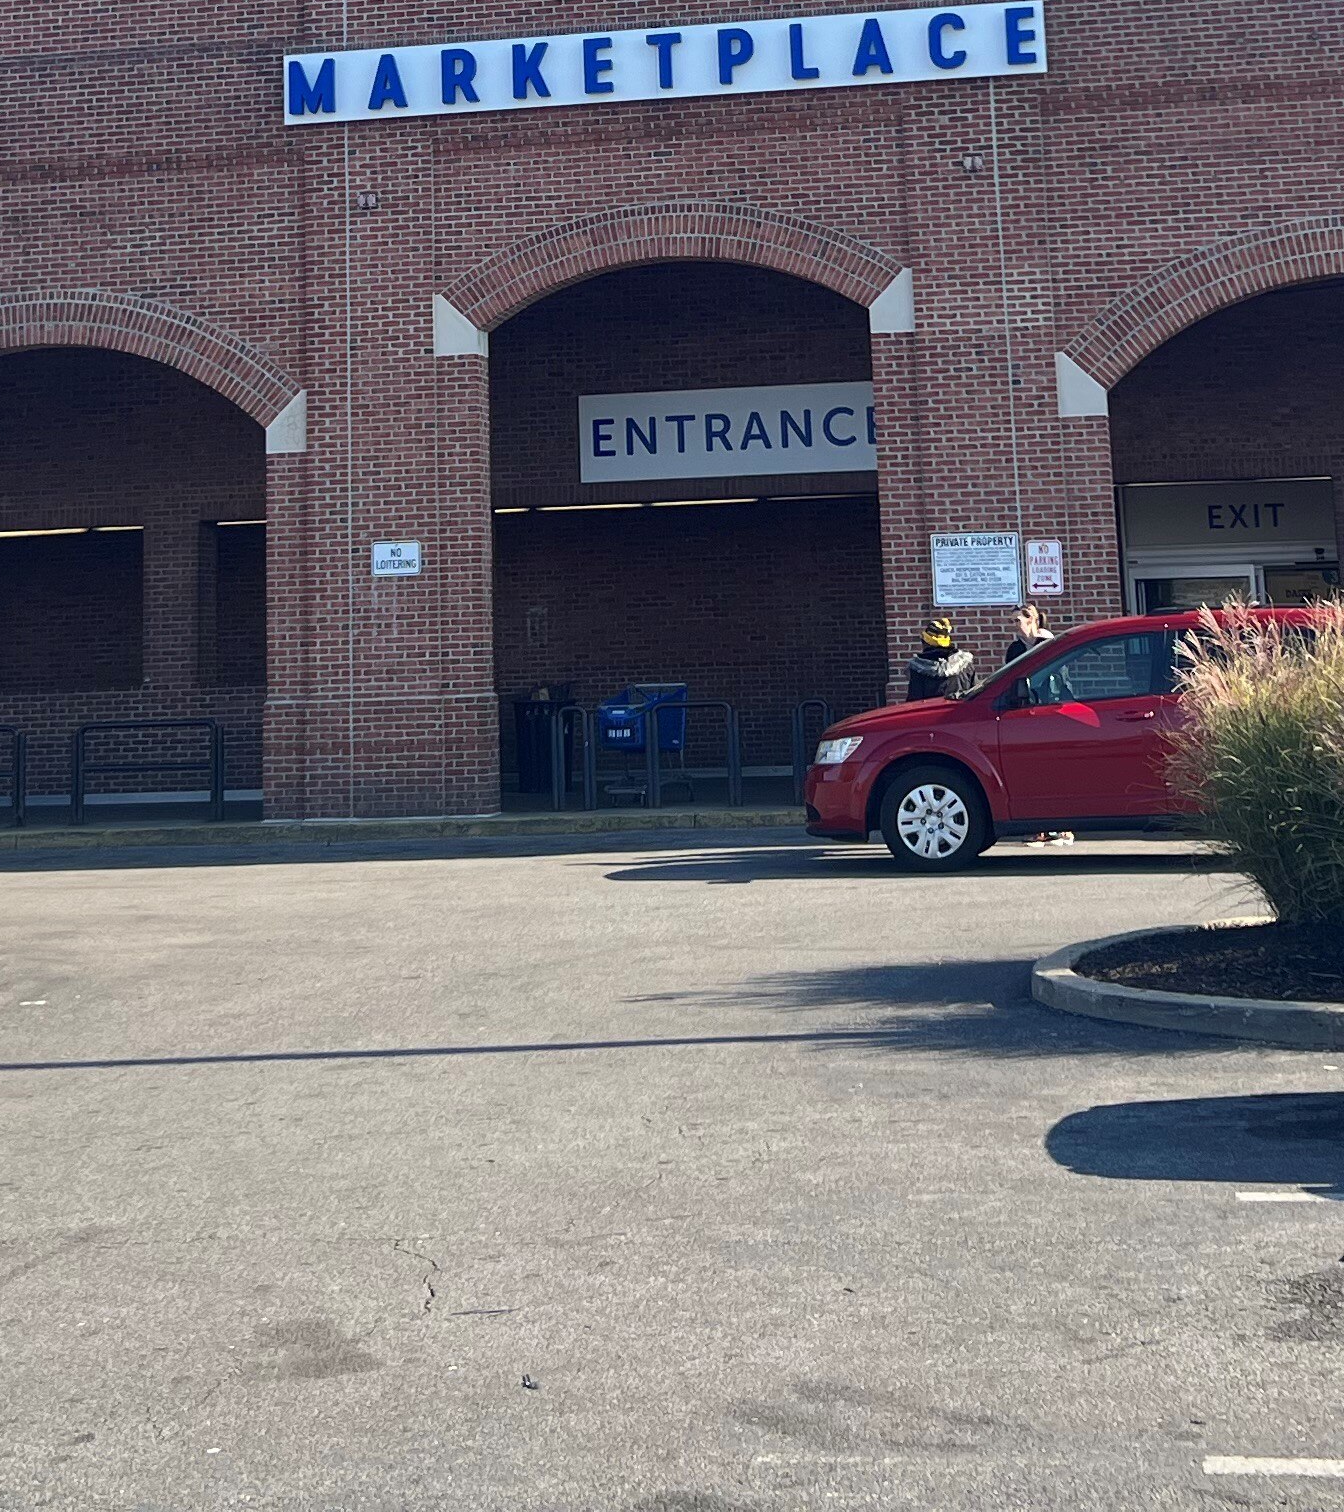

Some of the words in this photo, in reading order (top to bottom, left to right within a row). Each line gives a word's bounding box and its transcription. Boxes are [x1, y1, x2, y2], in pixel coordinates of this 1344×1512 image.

[288, 6, 1037, 116] MARKETPLACE
[1208, 503, 1285, 529] EXIT
[936, 537, 968, 547] PRIVATE
[971, 536, 1014, 547] PROPERTY
[390, 548, 402, 557] NO
[376, 559, 416, 570] LOITERING
